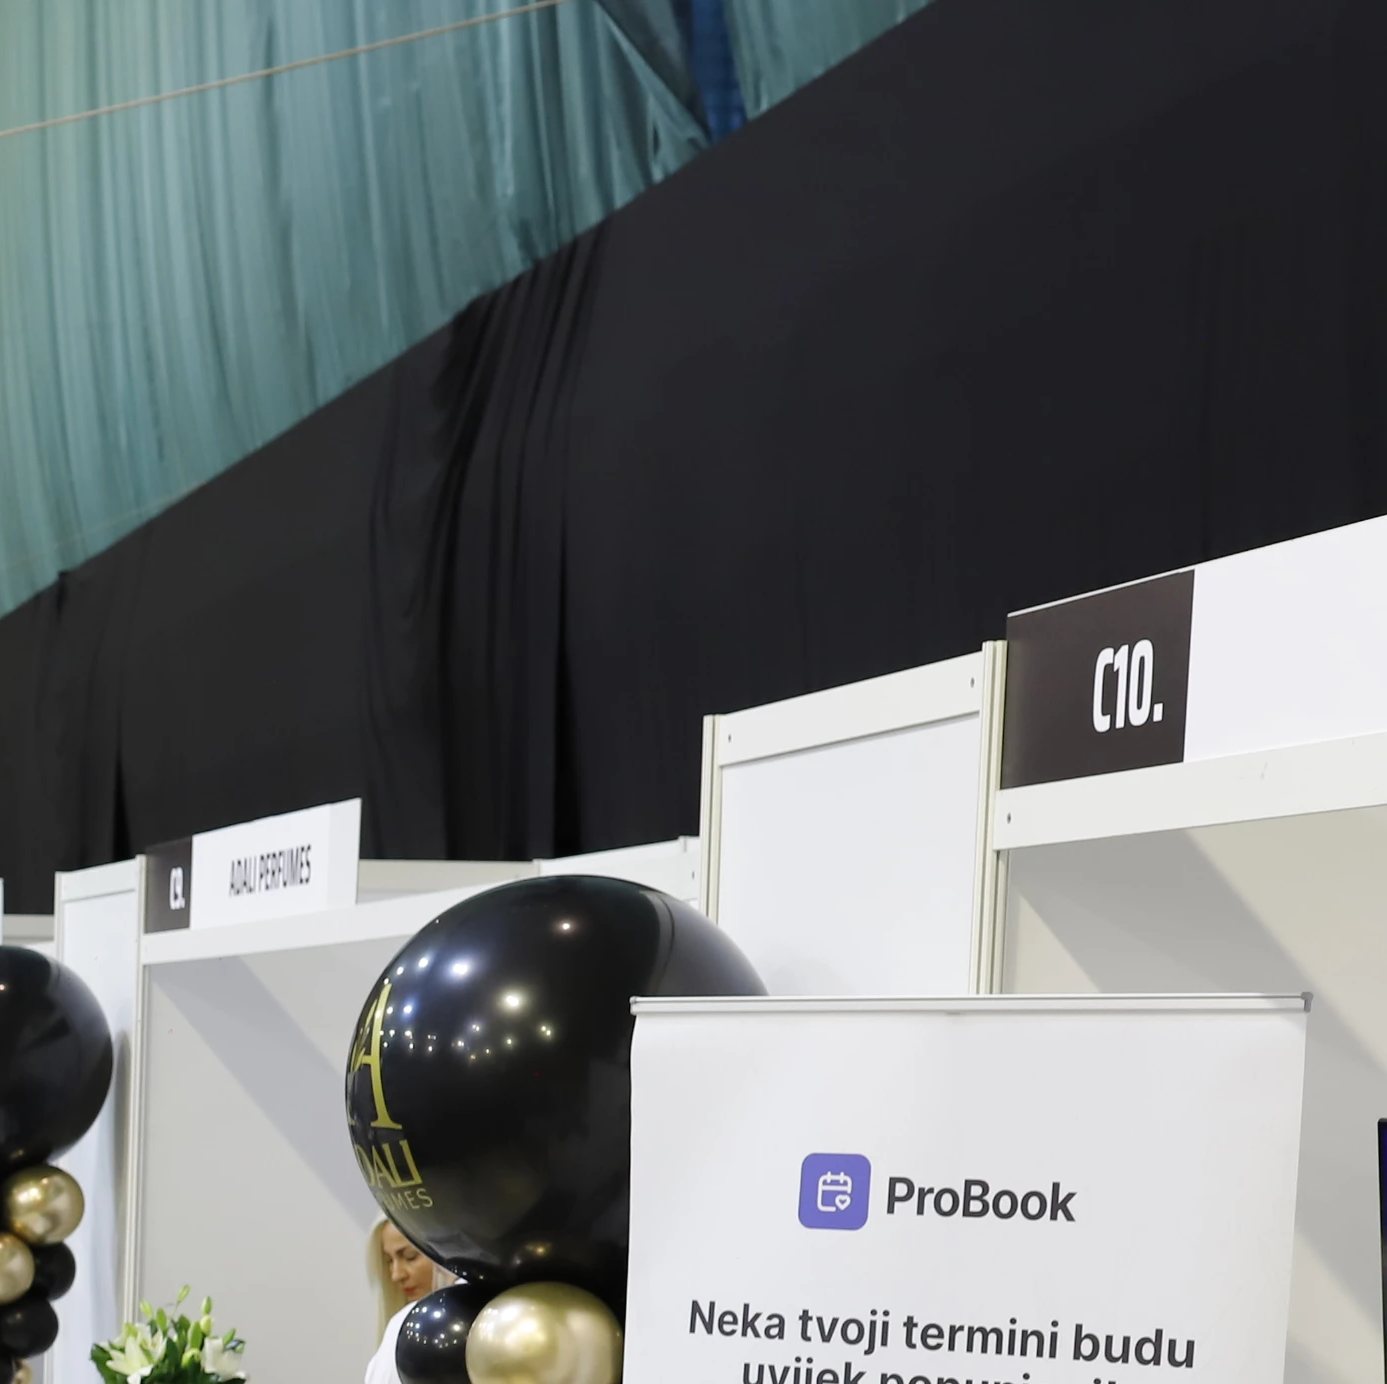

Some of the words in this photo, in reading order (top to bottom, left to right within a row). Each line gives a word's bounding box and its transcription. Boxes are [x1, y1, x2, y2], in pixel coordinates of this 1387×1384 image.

[1092, 638, 1164, 733] C10.
[229, 856, 257, 898] ADALI
[259, 844, 312, 892] PERFUMES
[885, 1176, 1078, 1223] ProBook
[688, 1300, 787, 1341] Neka
[798, 1309, 891, 1356] tvoji
[902, 1315, 1060, 1359] termini
[1072, 1323, 1197, 1368] budu
